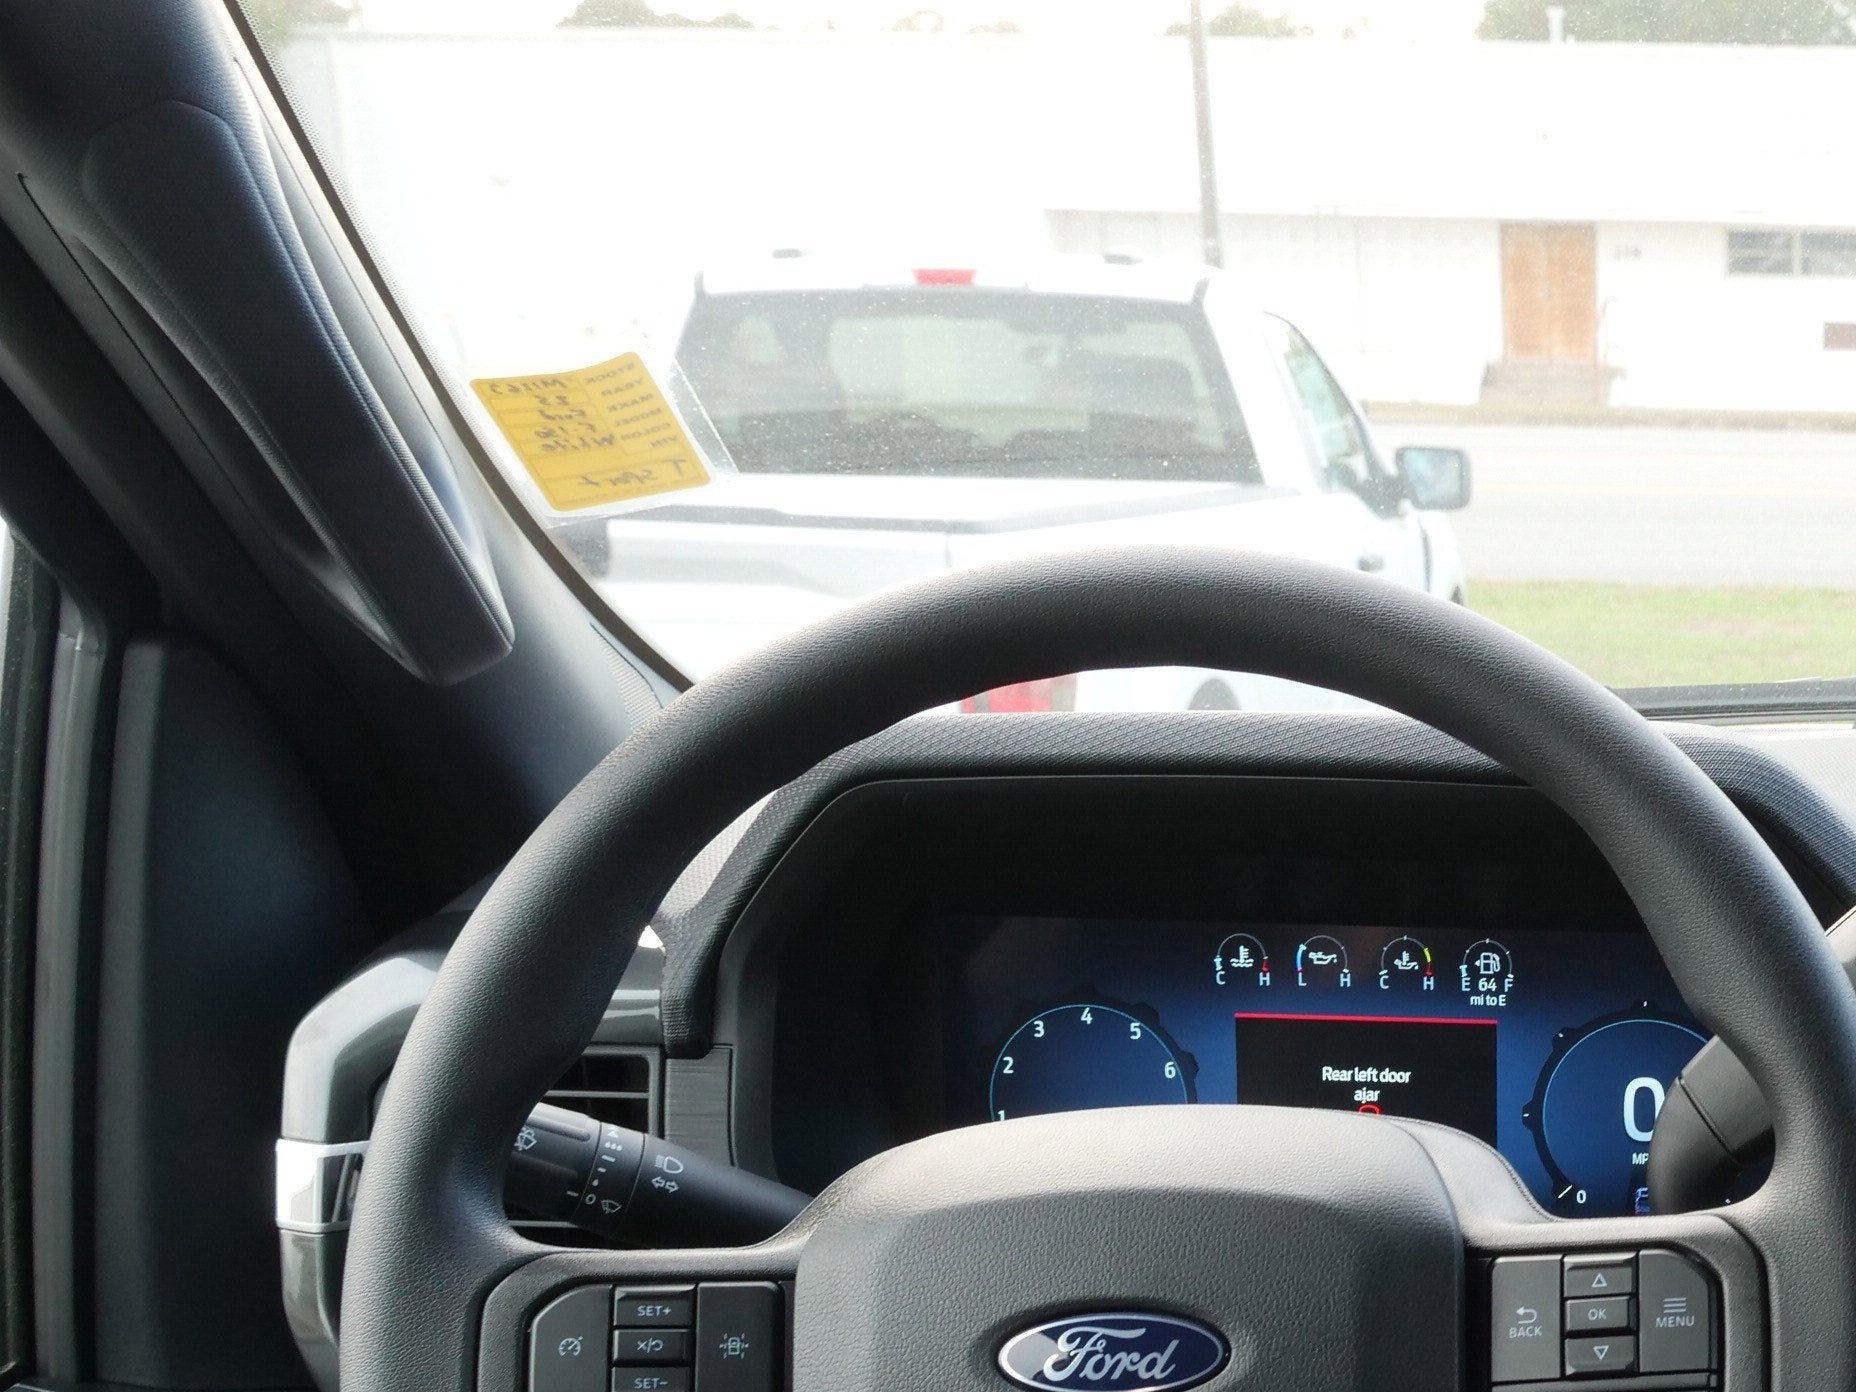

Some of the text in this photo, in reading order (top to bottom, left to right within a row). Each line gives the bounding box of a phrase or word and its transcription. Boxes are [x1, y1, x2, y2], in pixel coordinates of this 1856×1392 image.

[1215, 970, 1226, 986] C
[1259, 973, 1270, 986] H
[1298, 973, 1307, 986] L
[1340, 973, 1350, 987] H
[1379, 975, 1389, 989] C
[1423, 976, 1434, 990] H
[1461, 977, 1471, 992] E
[1478, 978, 1497, 992] 64
[1505, 978, 1514, 993] F
[1080, 1007, 1093, 1025] 4
[1033, 1020, 1045, 1038] 3
[1130, 1022, 1142, 1040] 5
[1002, 1056, 1014, 1074] 2
[1164, 1061, 1176, 1079] 6
[1322, 1066, 1411, 1085] Rear left door
[1354, 1087, 1380, 1104] ajar
[1576, 1190, 1587, 1204] 0
[637, 1306, 671, 1317] SET+
[1588, 1308, 1607, 1321] OK
[1655, 1315, 1695, 1328] MENU
[1508, 1325, 1543, 1339] BACK
[1043, 1326, 1181, 1382] Ford
